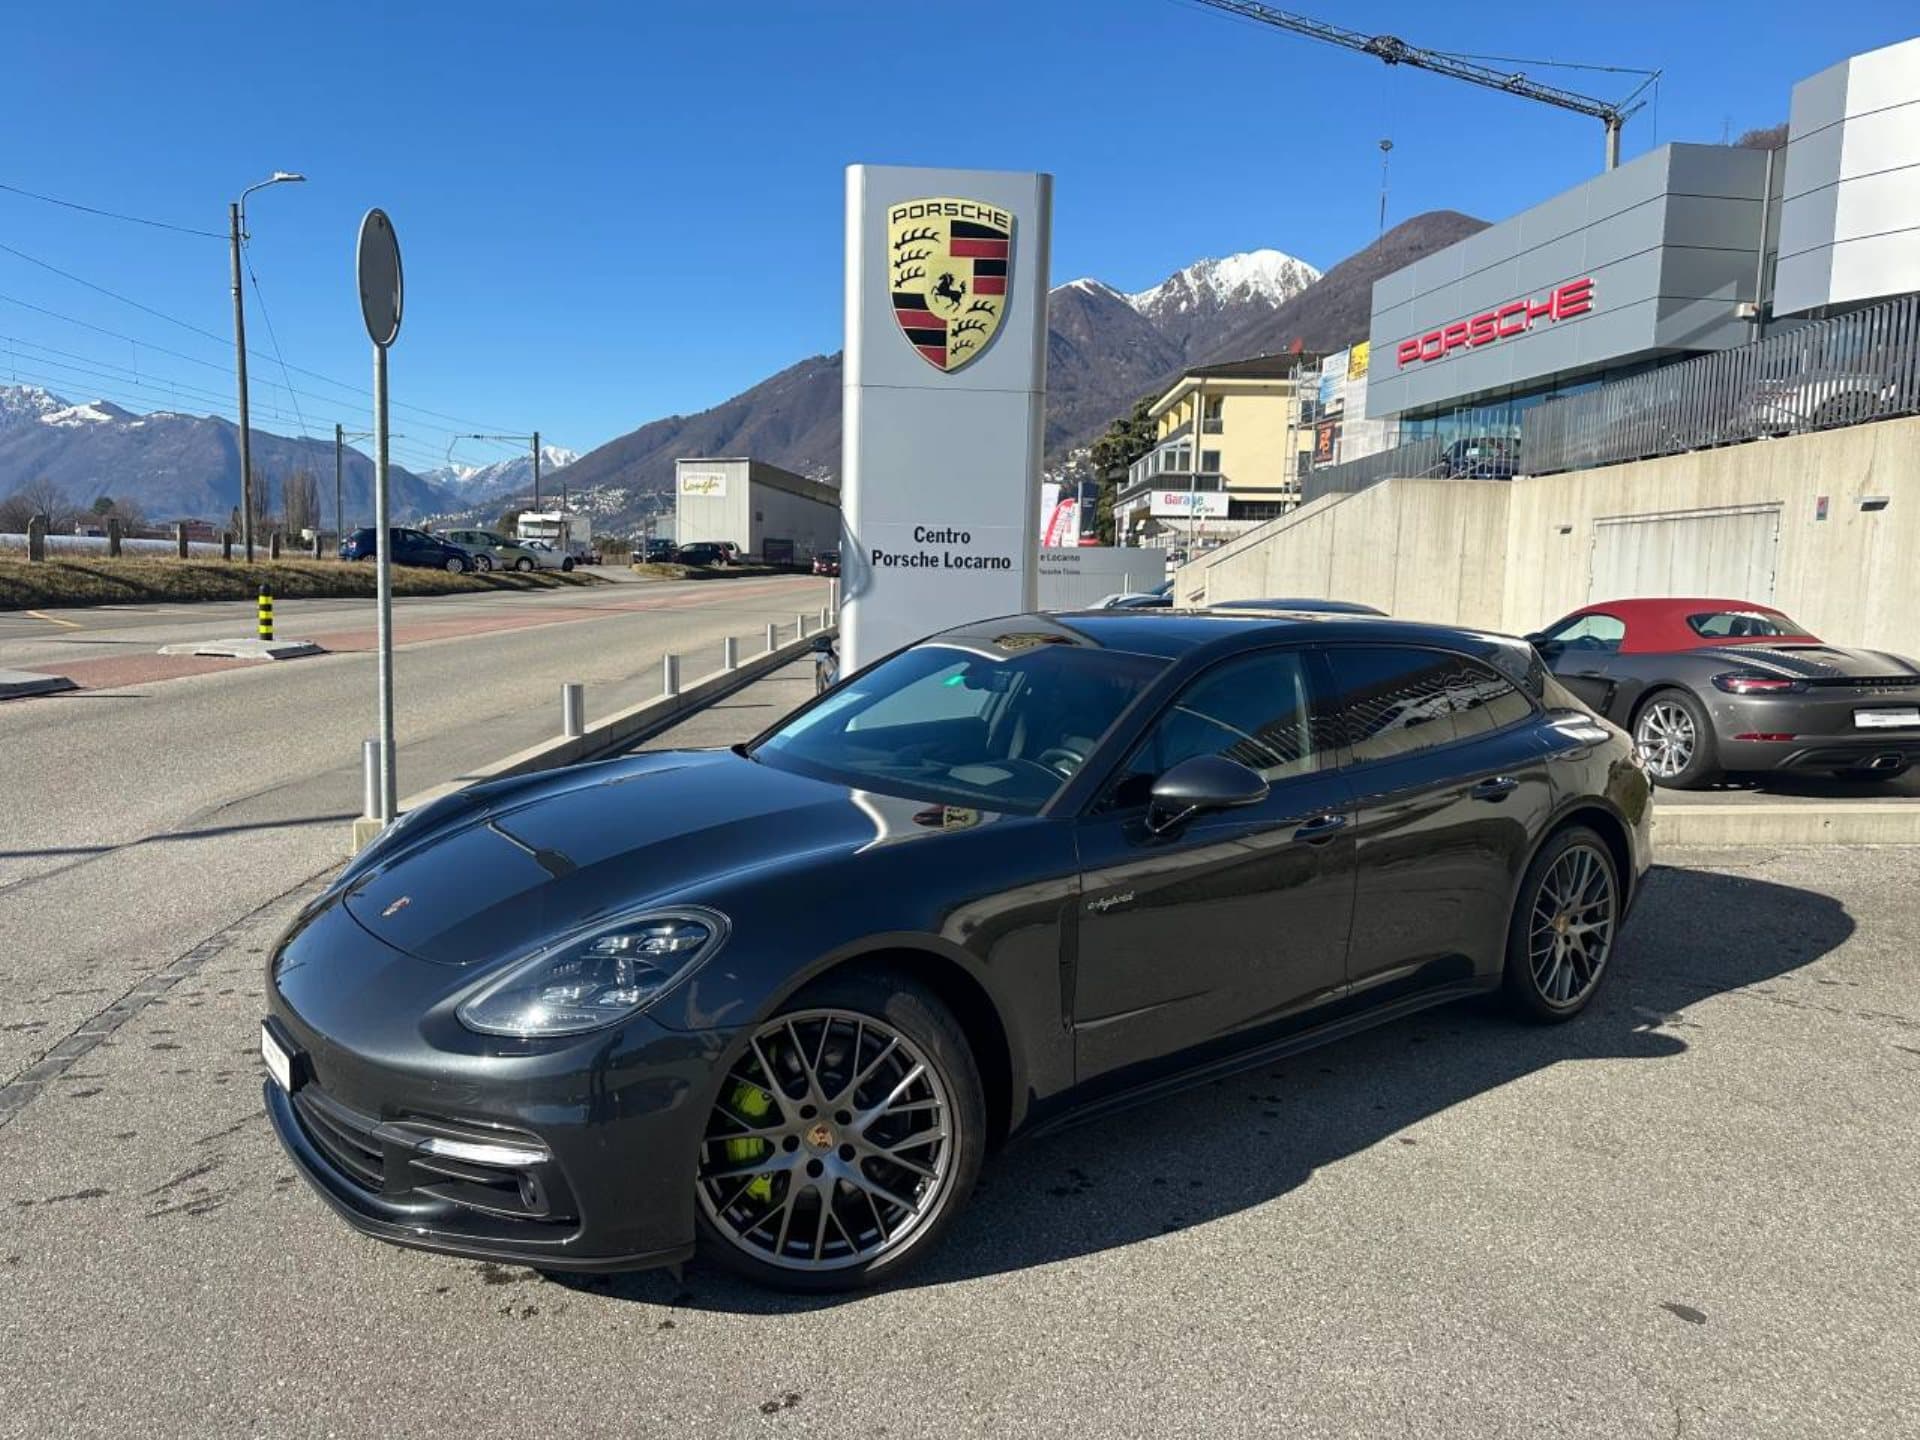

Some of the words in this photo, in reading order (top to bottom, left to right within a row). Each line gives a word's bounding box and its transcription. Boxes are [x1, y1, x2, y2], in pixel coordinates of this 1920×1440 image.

[892, 203, 1009, 229] PORSCHE
[1397, 277, 1596, 370] PORSCHE
[913, 526, 971, 544] Centro
[871, 549, 939, 568] Porsche
[944, 551, 1011, 569] Locarno
